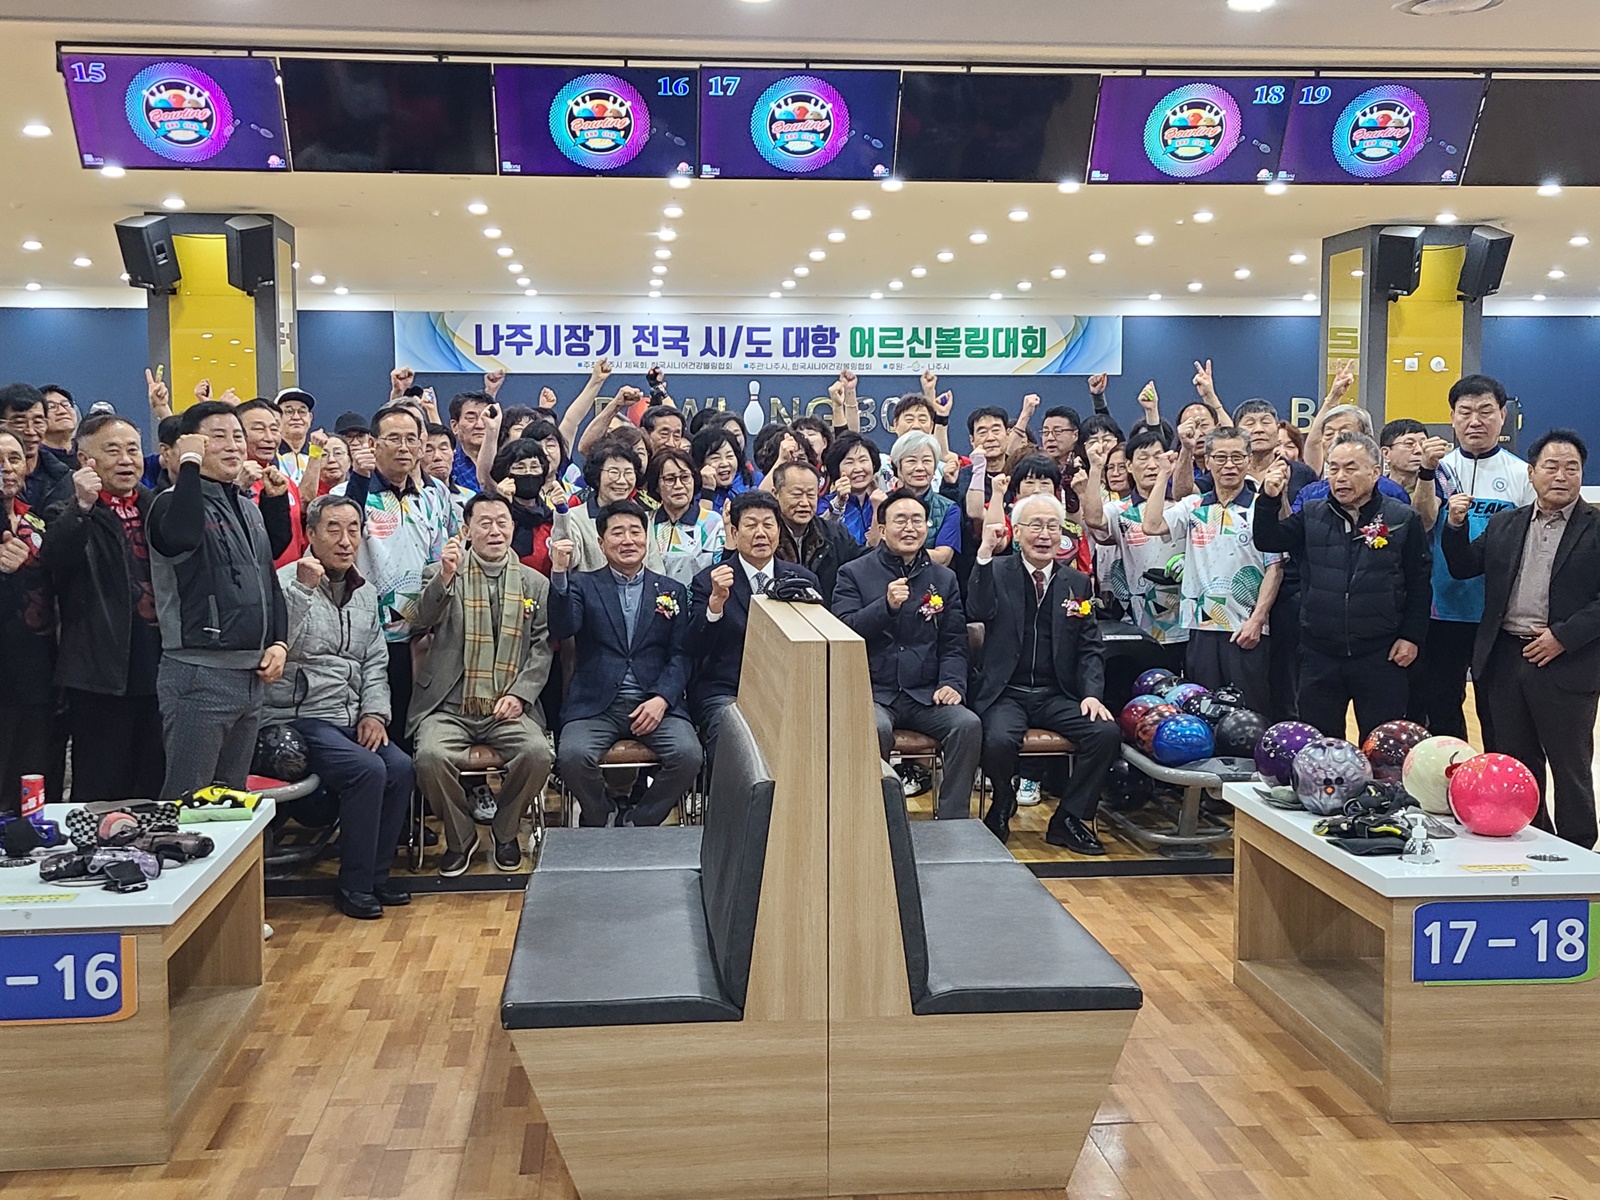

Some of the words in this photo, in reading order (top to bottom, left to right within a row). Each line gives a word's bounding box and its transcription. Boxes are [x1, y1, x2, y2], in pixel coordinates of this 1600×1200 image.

[71, 62, 107, 83] 15
[657, 76, 689, 96] 16
[708, 76, 740, 96] 17
[1252, 85, 1285, 104] 18
[1298, 85, 1332, 105] 19
[149, 107, 212, 122] Bowling
[570, 117, 631, 131] Bowling
[771, 119, 830, 134] Bowling
[1163, 125, 1222, 140] Bowling
[1352, 127, 1410, 141] Bowling
[474, 323, 621, 357] 나주시장기
[632, 324, 690, 358] 전국
[699, 324, 773, 359] 시/도
[782, 325, 840, 358] 대항
[849, 325, 1047, 359] 어르신볼링대회
[928, 362, 950, 371] 나주시
[54, 953, 119, 1001] 16
